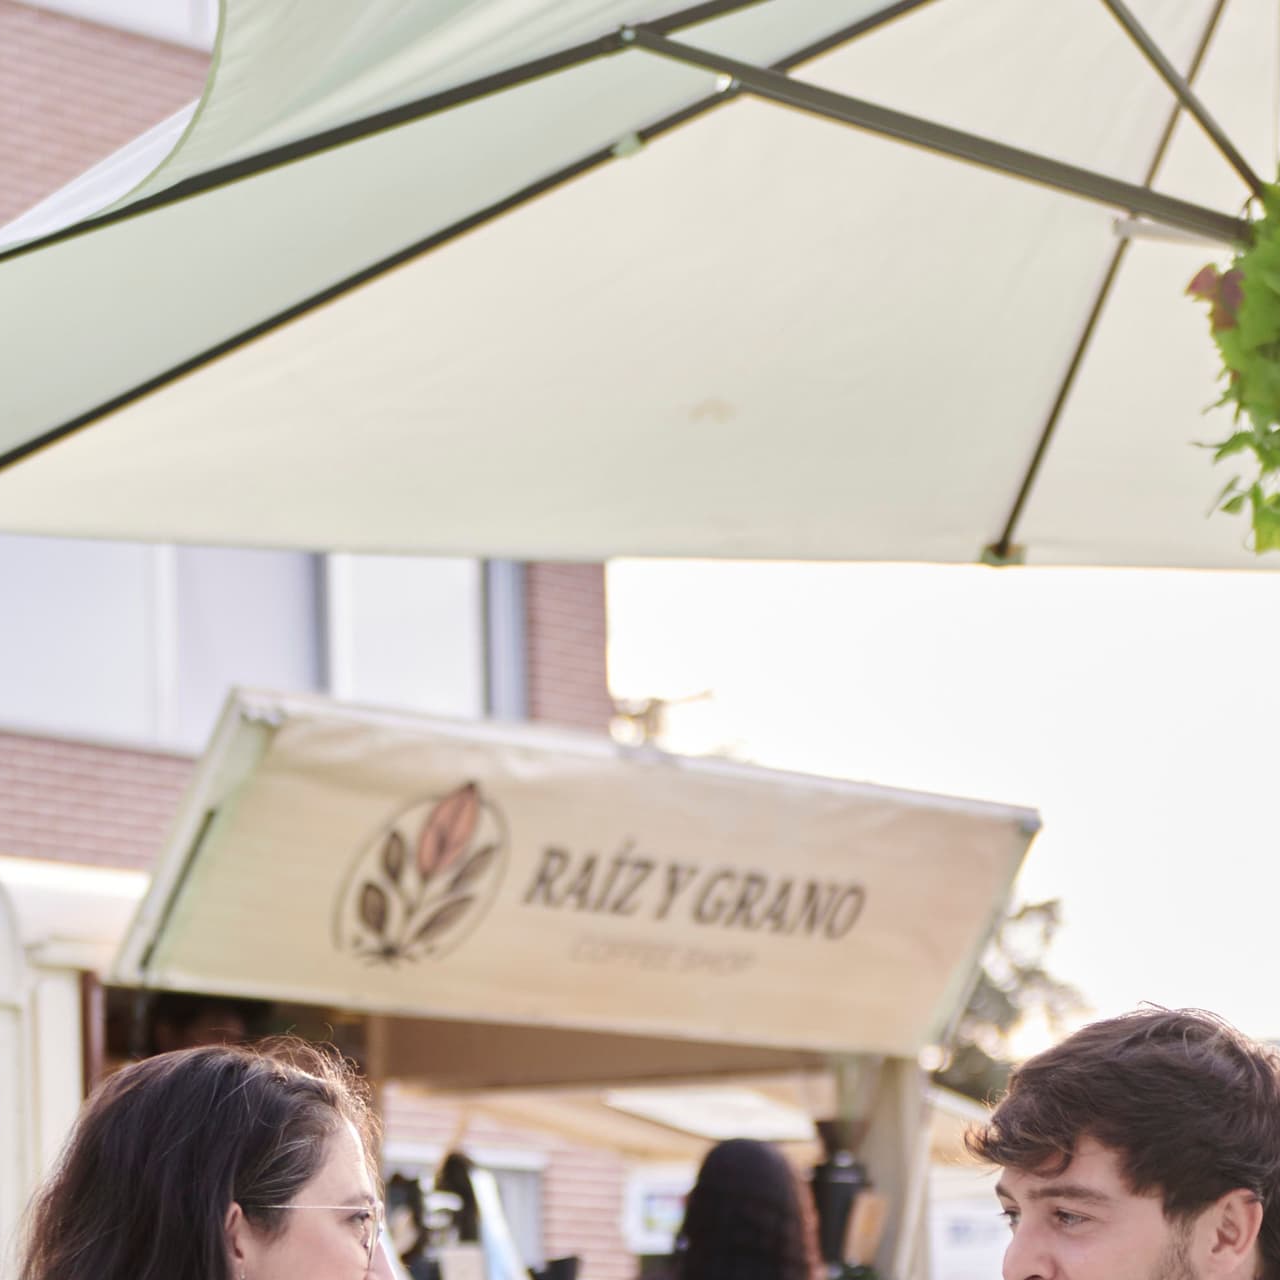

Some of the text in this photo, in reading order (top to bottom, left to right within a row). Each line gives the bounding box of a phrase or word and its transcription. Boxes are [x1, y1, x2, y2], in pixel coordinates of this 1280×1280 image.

[522, 837, 868, 941] RAÍZ Y GRANO
